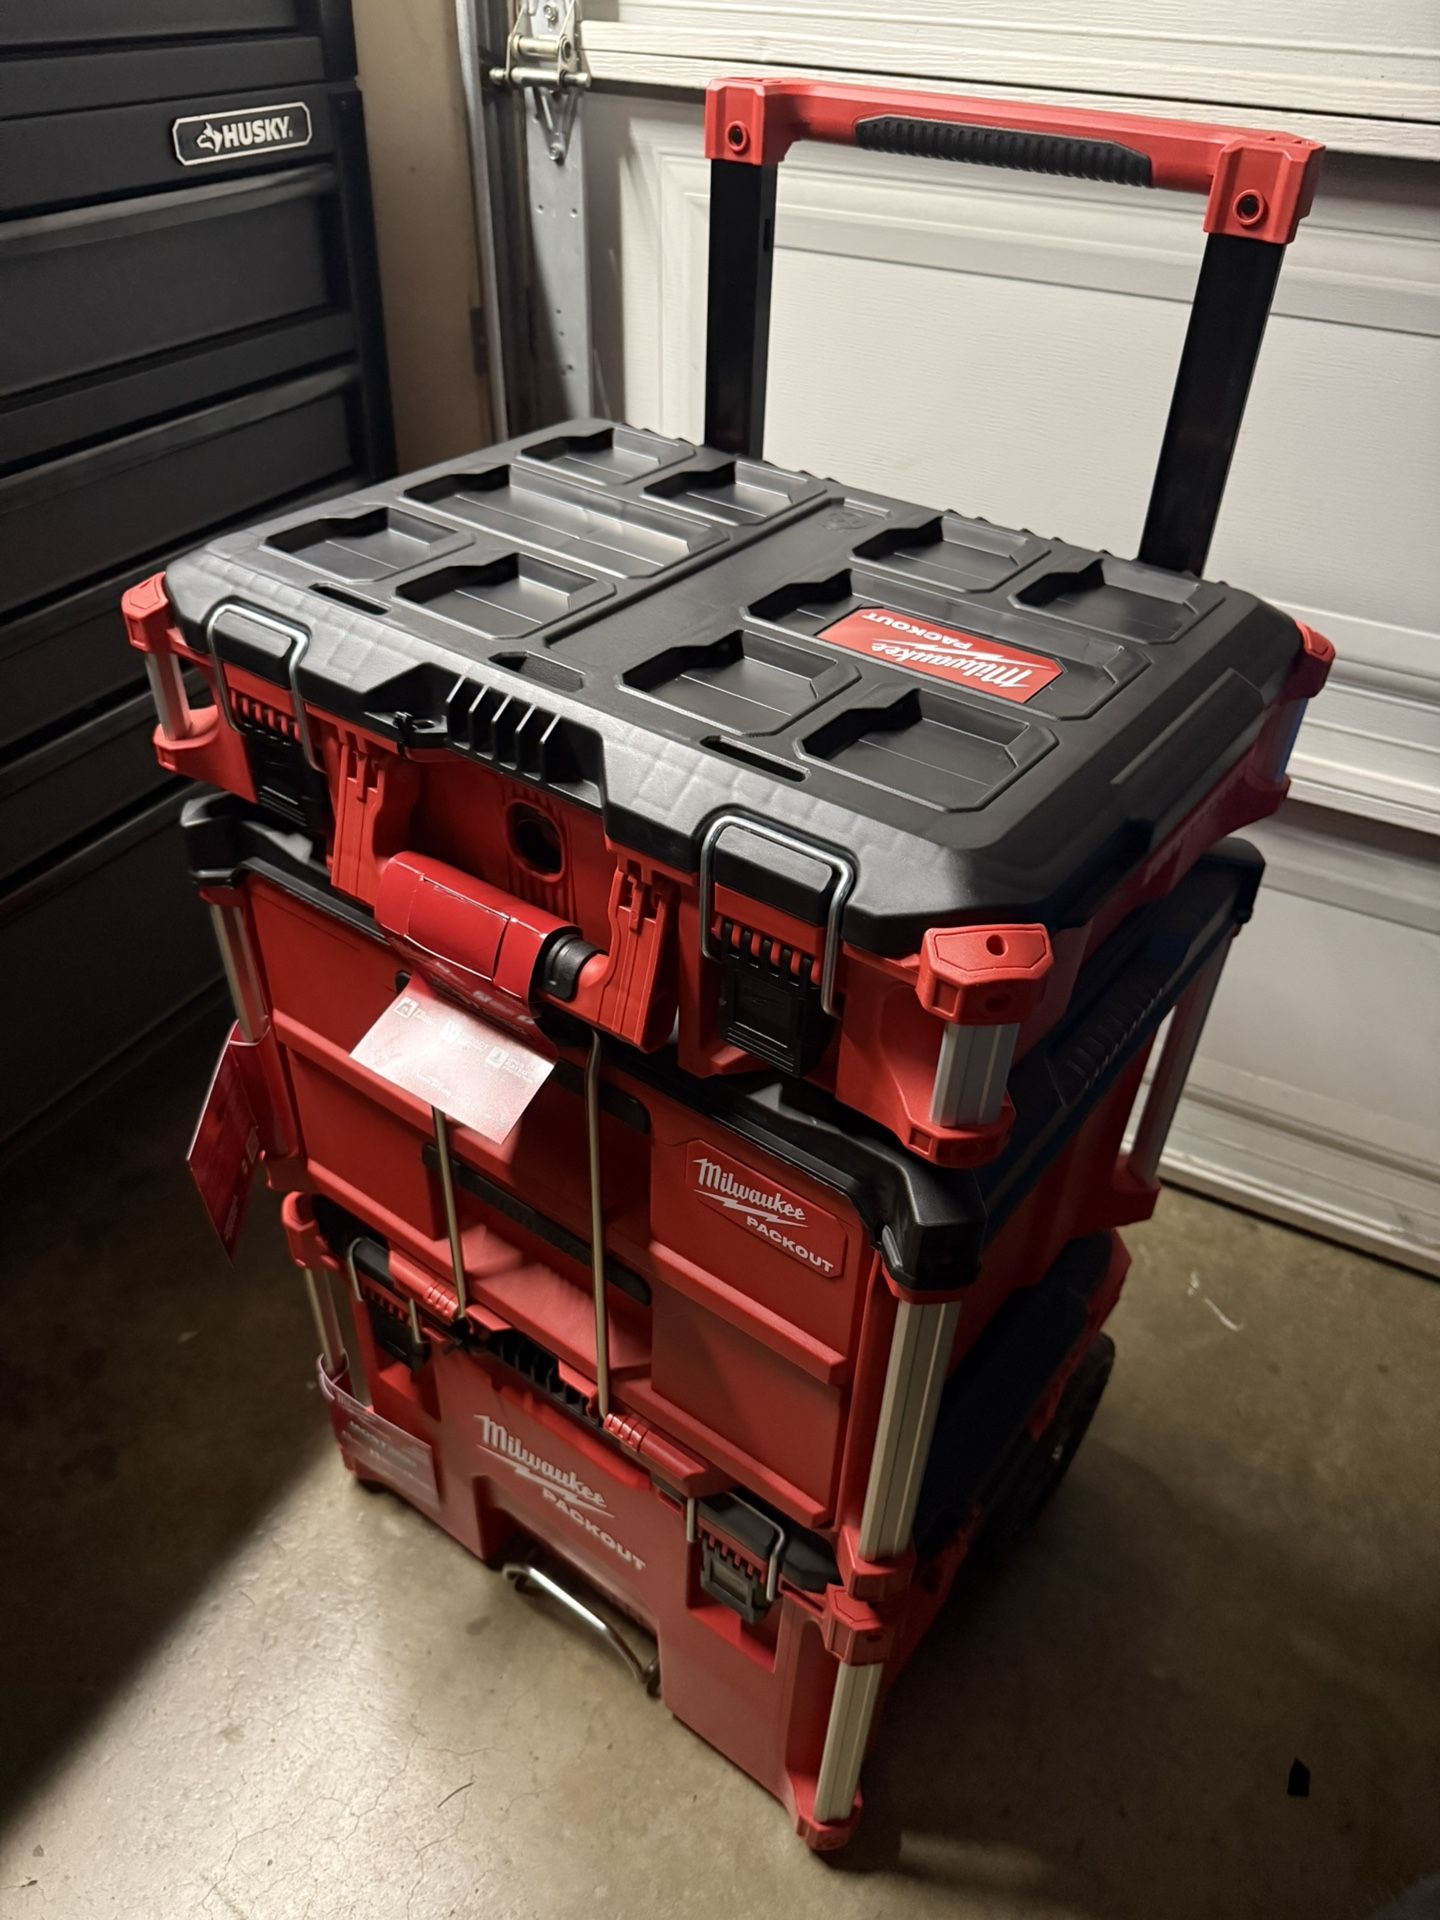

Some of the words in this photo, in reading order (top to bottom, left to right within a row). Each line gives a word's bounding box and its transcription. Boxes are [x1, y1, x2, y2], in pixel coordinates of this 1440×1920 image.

[222, 116, 290, 148] HUSKY
[862, 612, 973, 650] PACKOUT
[871, 642, 1032, 688] Milwaukee
[692, 1158, 806, 1220] Milwaukee
[746, 1215, 834, 1273] PACKOUT
[474, 1414, 607, 1508] Milwaukee
[542, 1487, 646, 1571] PACKOUT
